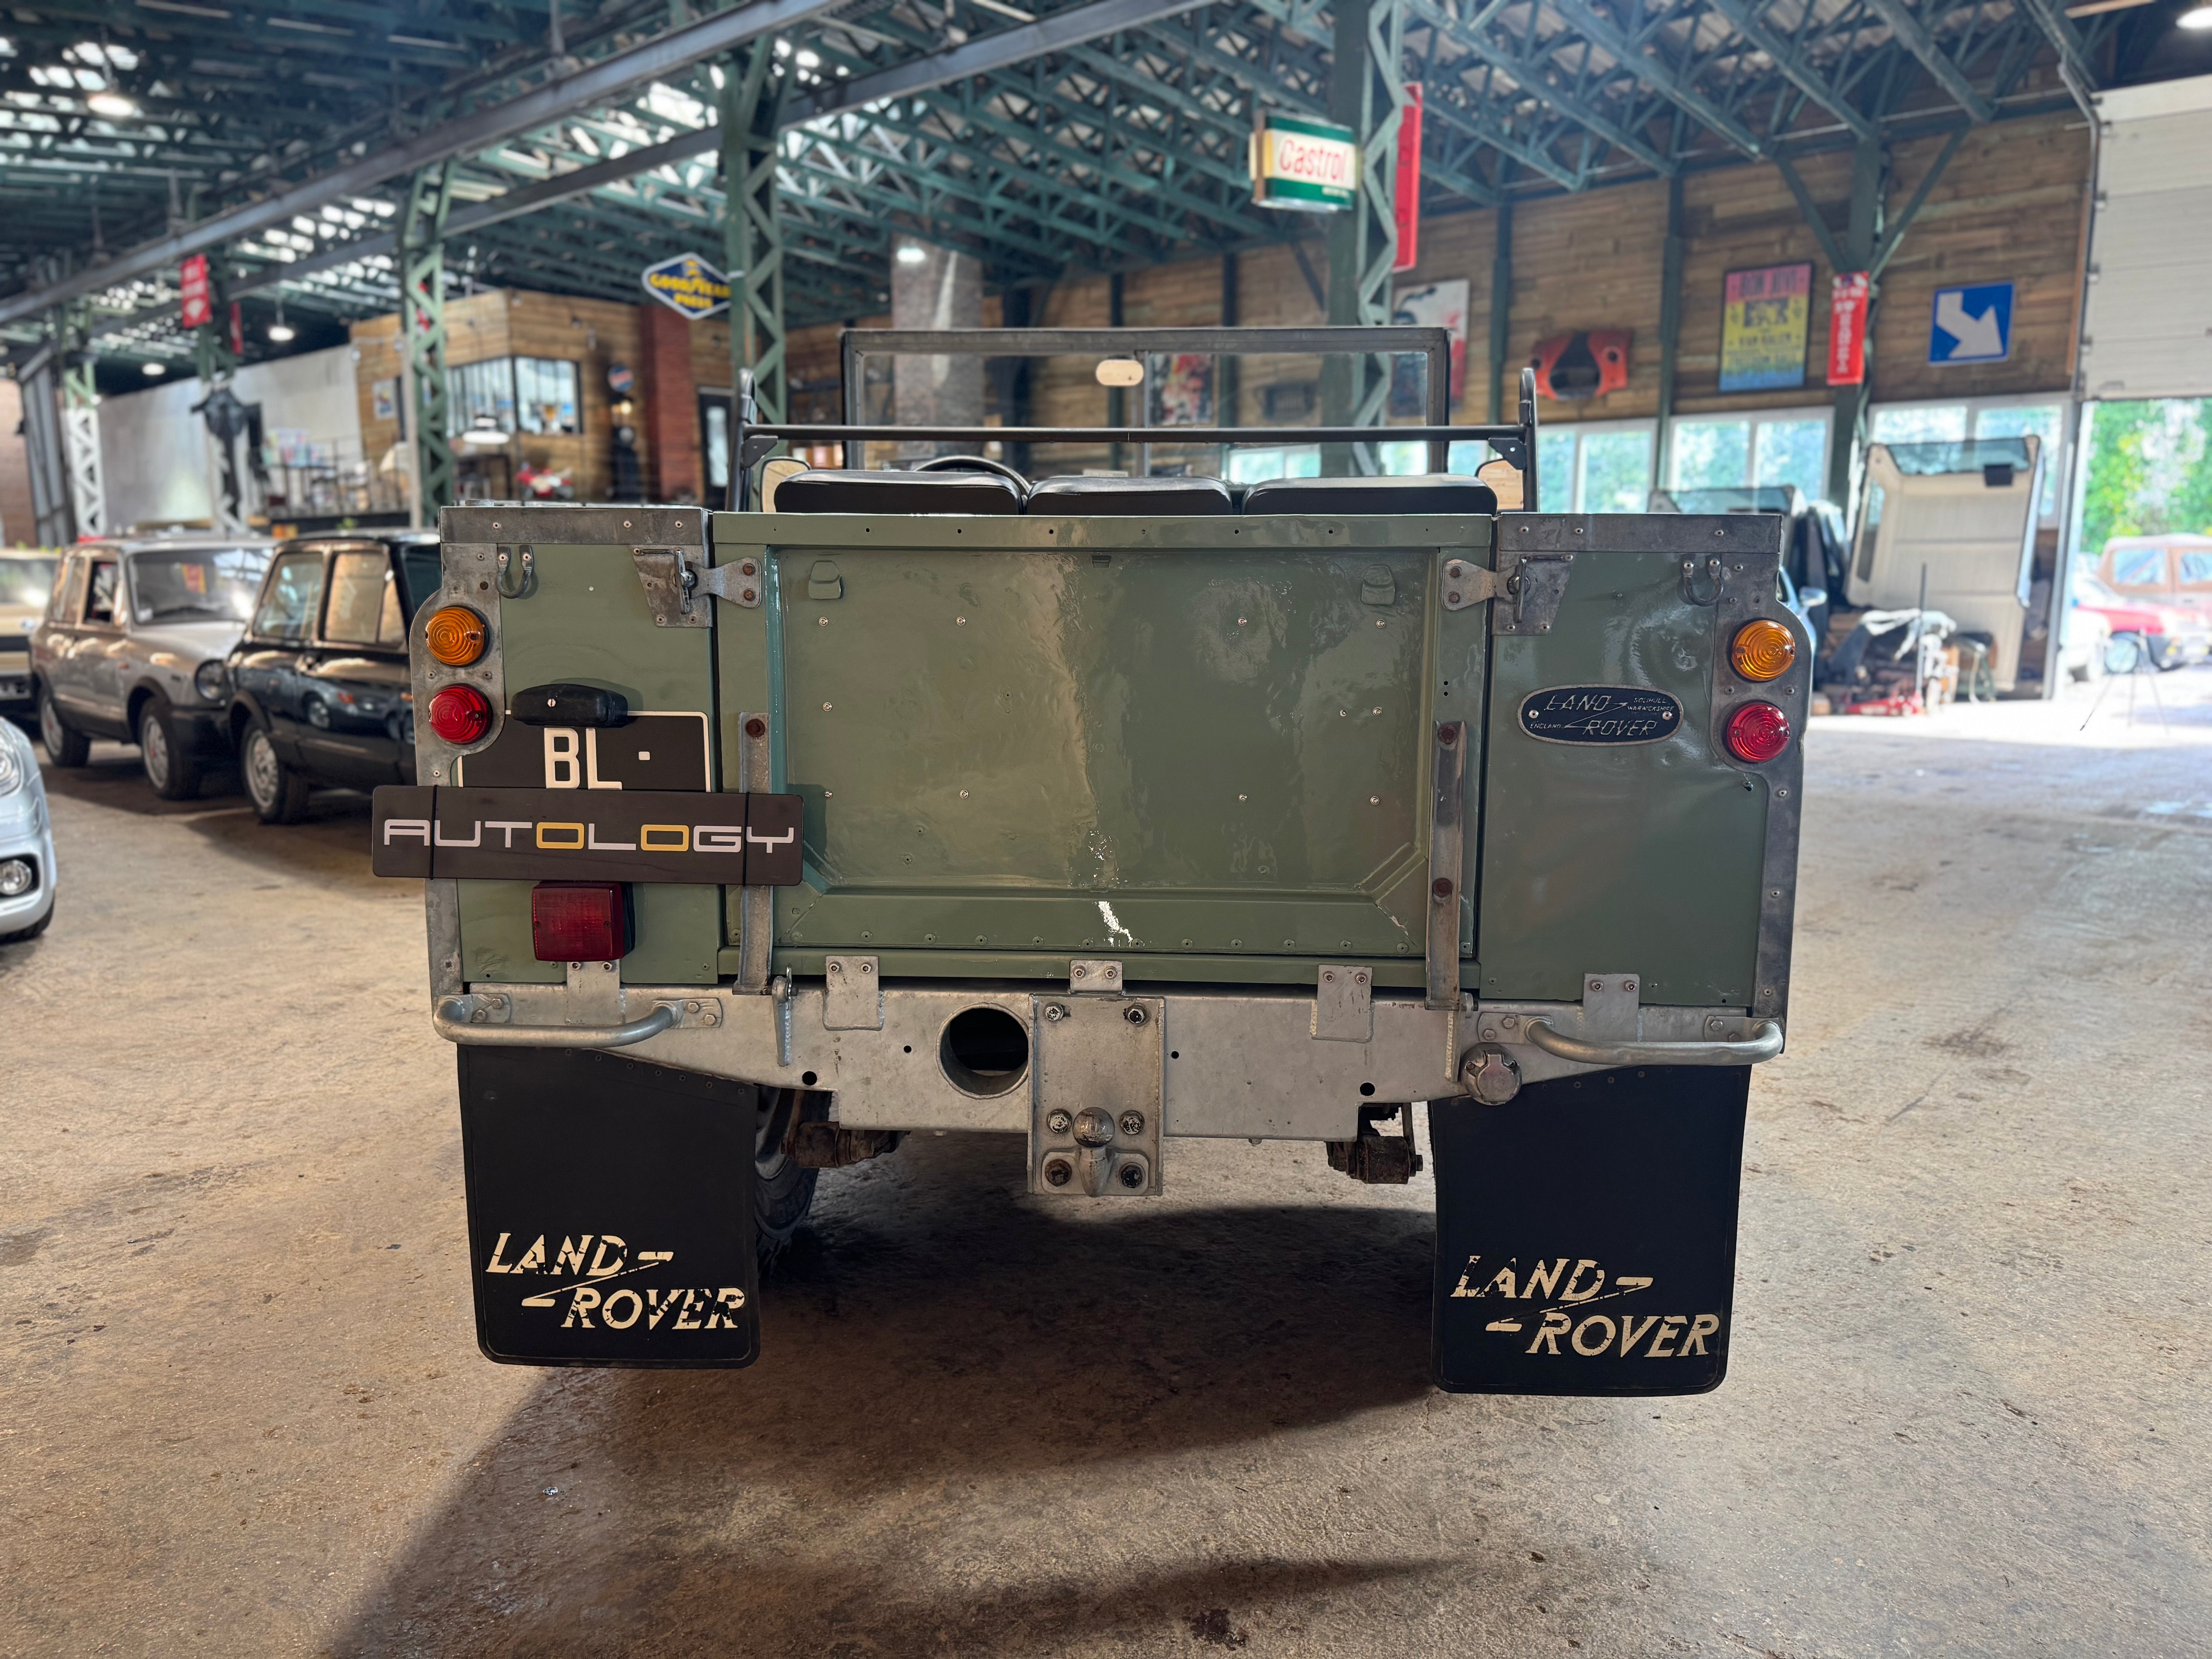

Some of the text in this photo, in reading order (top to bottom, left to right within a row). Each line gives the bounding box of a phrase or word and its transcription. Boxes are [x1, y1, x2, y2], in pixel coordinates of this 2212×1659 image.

[1279, 140, 1348, 182] Castrol
[1544, 694, 1611, 711] LAND
[1582, 720, 1657, 736] ROVER
[384, 819, 794, 854] AUTOLOGY
[485, 1233, 628, 1276] LAND
[1450, 1255, 1605, 1301] LAND
[561, 1287, 745, 1330] ROVER
[1525, 1312, 1720, 1358] ROVER
